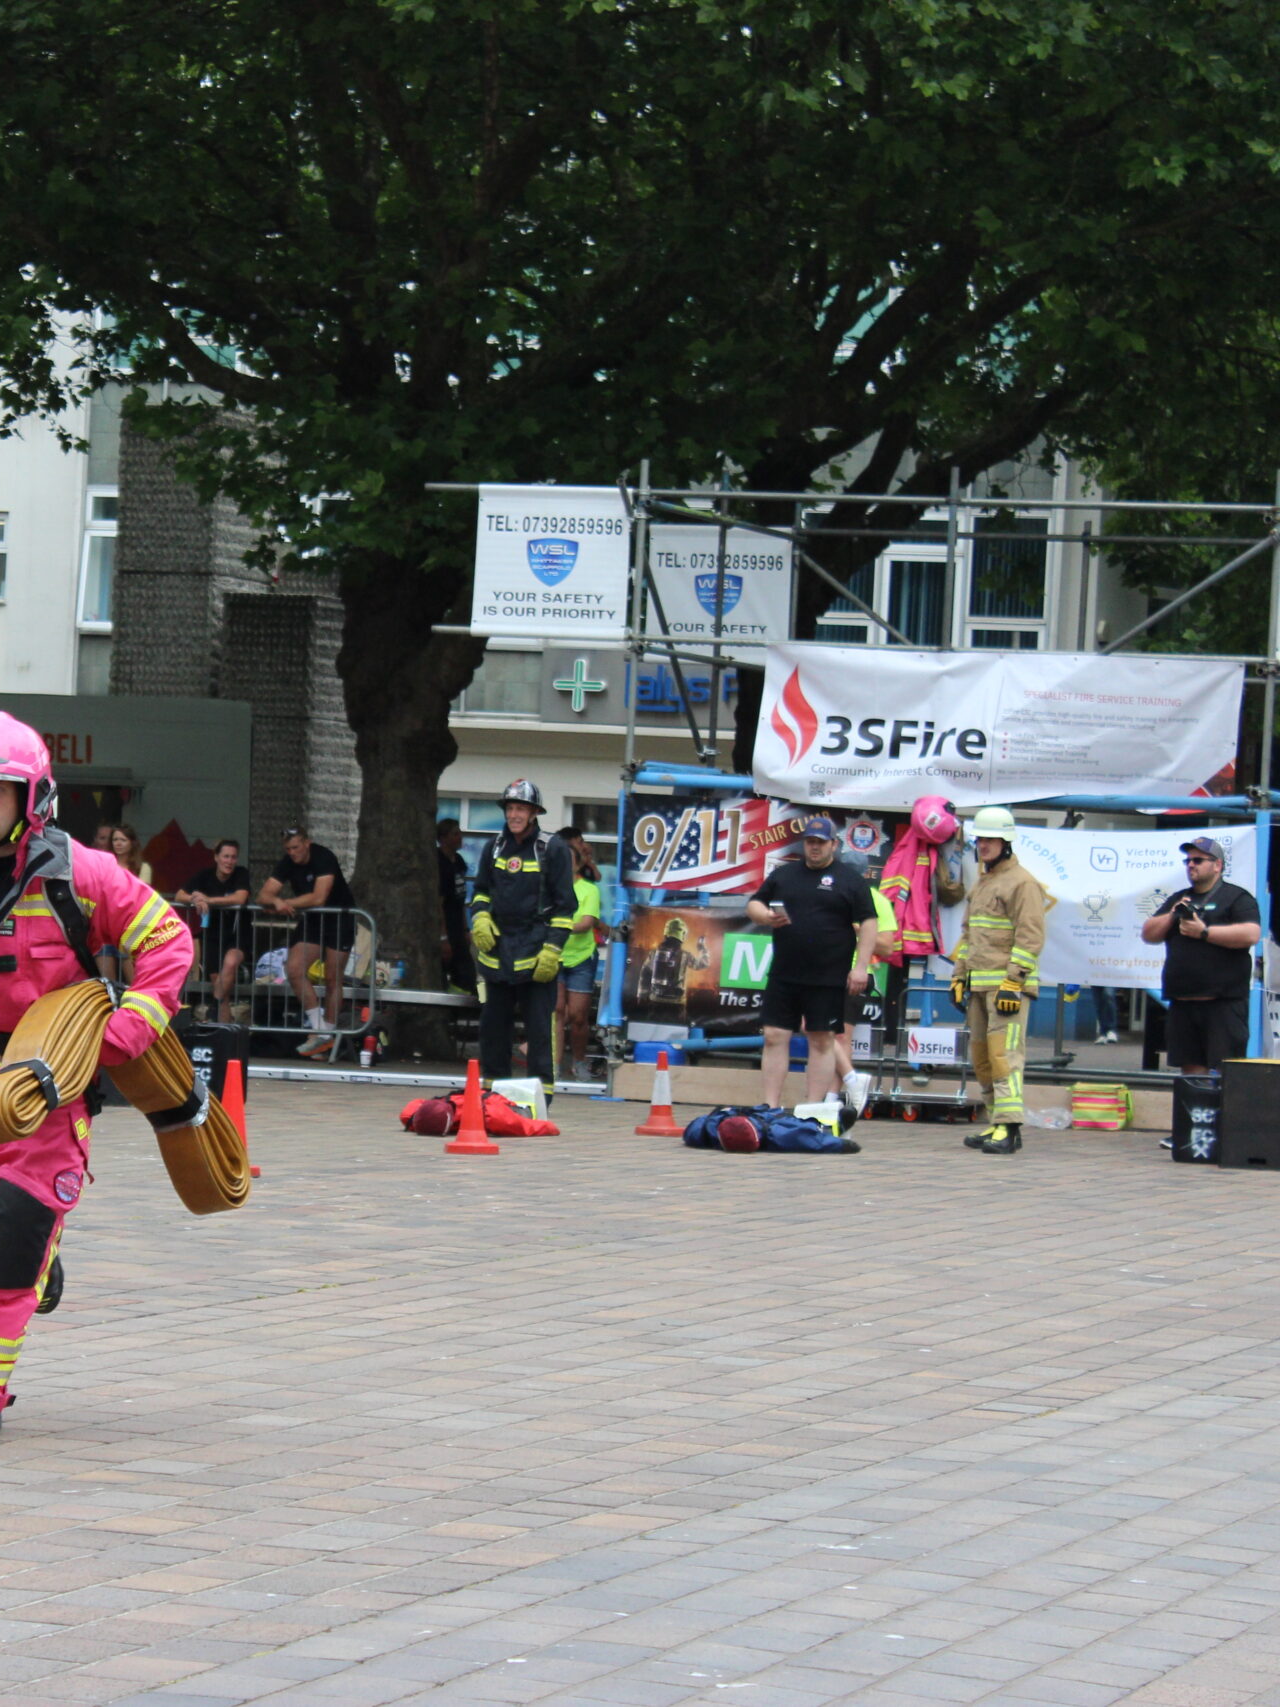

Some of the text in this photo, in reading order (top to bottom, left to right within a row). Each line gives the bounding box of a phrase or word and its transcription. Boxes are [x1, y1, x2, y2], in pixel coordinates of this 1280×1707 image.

[486, 514, 623, 536] TEL: 07392859596
[529, 543, 576, 555] WSL
[657, 552, 783, 571] TEL: 0732859596
[493, 591, 604, 604] YOUR SAFETY
[483, 606, 616, 620] IS OUR PRIORITY
[1097, 694, 1134, 705] SERVICE
[1137, 696, 1182, 708] TRAINING
[820, 715, 987, 761] 3SFire
[811, 763, 881, 780] Community
[883, 765, 922, 778] Interest
[925, 766, 983, 782] Company
[633, 807, 743, 887] 9/11
[748, 824, 788, 850] STAIR
[1020, 834, 1069, 881] Trophies
[1126, 848, 1168, 858] Victory
[1125, 860, 1174, 870] Trophies
[719, 992, 747, 1007] The
[919, 1043, 954, 1055] 3SFire
